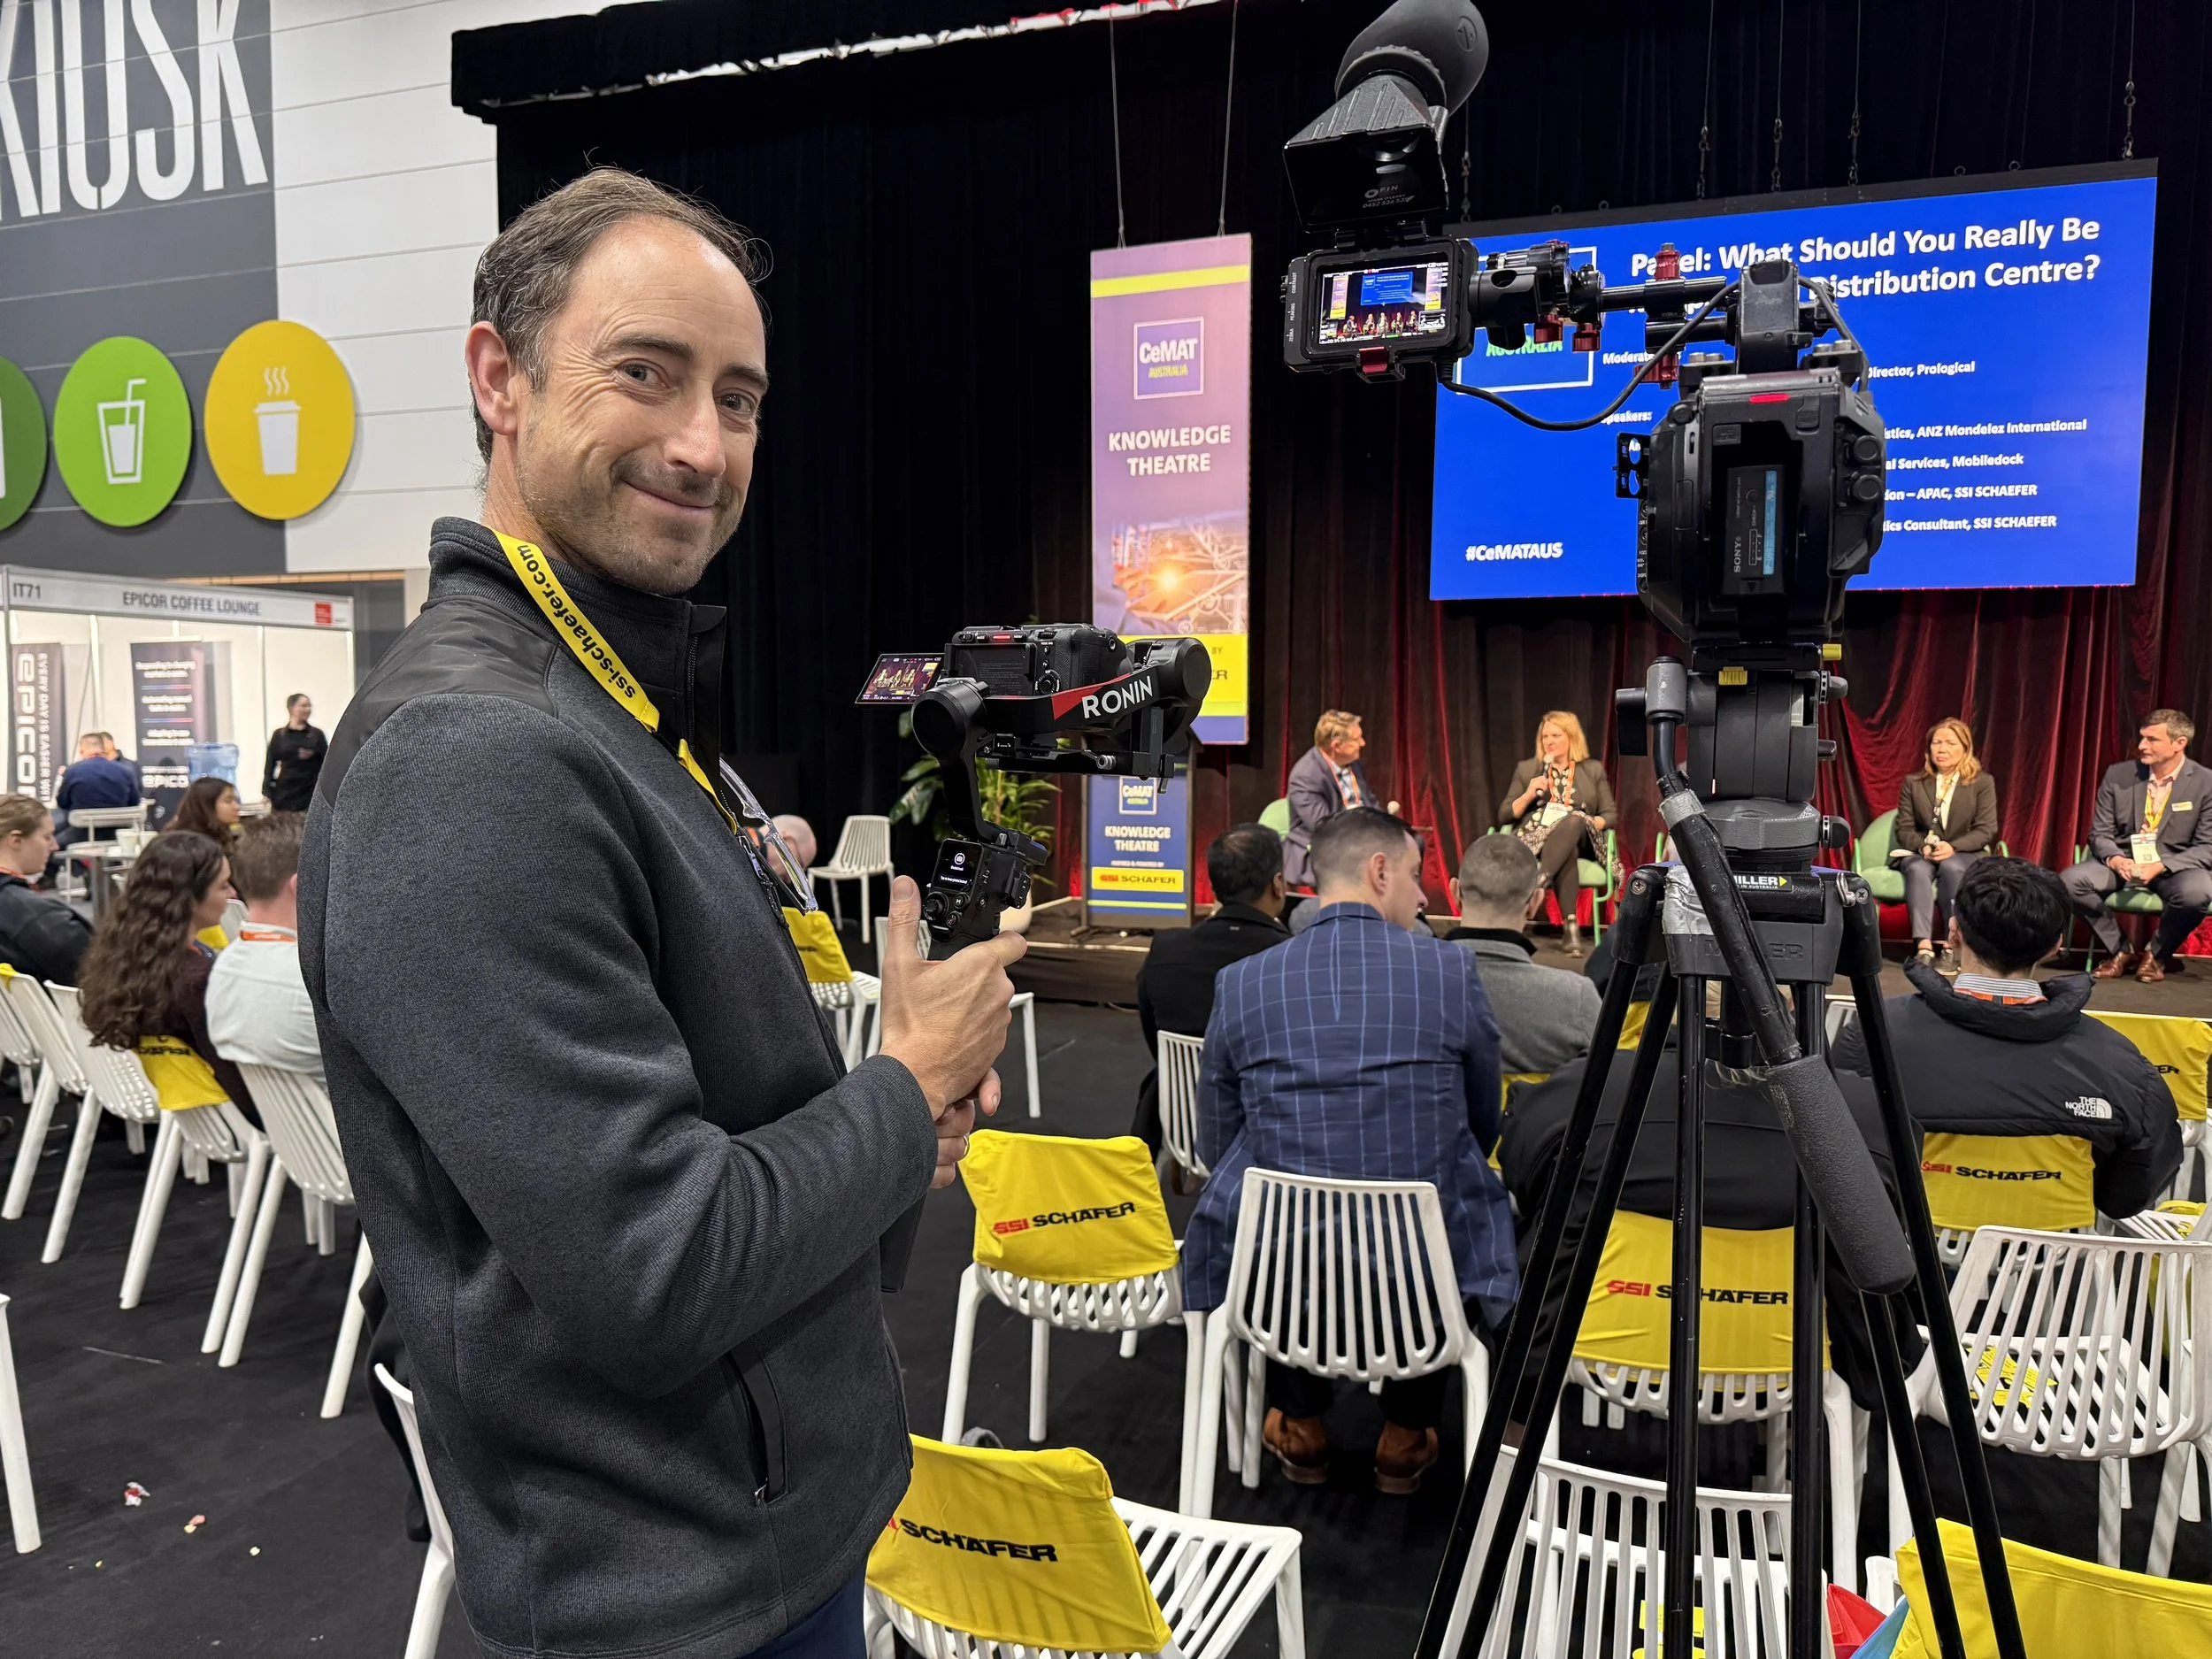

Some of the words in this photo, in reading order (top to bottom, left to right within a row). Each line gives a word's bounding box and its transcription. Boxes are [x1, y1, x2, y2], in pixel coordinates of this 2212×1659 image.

[1631, 247, 1712, 277] Pael:
[1718, 242, 1793, 270] What
[1799, 230, 1895, 264] Should
[1902, 229, 1955, 254] You
[1964, 219, 2054, 250] Really
[2062, 217, 2101, 242] Be
[1985, 254, 2101, 286] Centre?
[1139, 338, 1198, 364] CeMAT
[1486, 335, 1563, 357] AURALIA
[1148, 365, 1188, 379] AUSTRALIA
[1602, 350, 1681, 365] Moderat
[1916, 361, 1975, 377] Prological
[1109, 425, 1232, 451] KNOWLEDGE
[1916, 426, 1943, 438] ANZ
[1945, 422, 2005, 437] Mondelez
[2007, 419, 2087, 434] International
[1126, 452, 1211, 477] THEATRE
[1898, 456, 1949, 470] Services,
[1952, 453, 2024, 468] Mobiledock
[1916, 487, 1952, 500] APAC,
[1955, 487, 1973, 498] SSI
[1975, 485, 2038, 497] SCHAEFER
[1903, 518, 1971, 531] Consultant,
[1973, 517, 1992, 529] SSI
[1994, 516, 2057, 528] SCHAEFER
[1465, 541, 1563, 564] #CeMATAUS
[13, 582, 42, 599] IT71
[122, 591, 168, 609] EPICOR
[171, 594, 214, 612] COFFEE
[216, 596, 262, 617] LOUNGE
[516, 543, 636, 699] ssi-schaefer.com
[1081, 675, 1154, 719] RONIN
[40, 779, 51, 802] WIT
[1104, 826, 1171, 839] KNOWLEDGE
[1115, 840, 1160, 852] THEATRE
[2064, 1101, 2096, 1112] NORTH
[2079, 1096, 2096, 1105] THE
[2074, 1109, 2096, 1118] FACE
[993, 1218, 1029, 1234] SSI
[1606, 1279, 1652, 1297] SSI
[1655, 1284, 1788, 1305] SHÄFER
